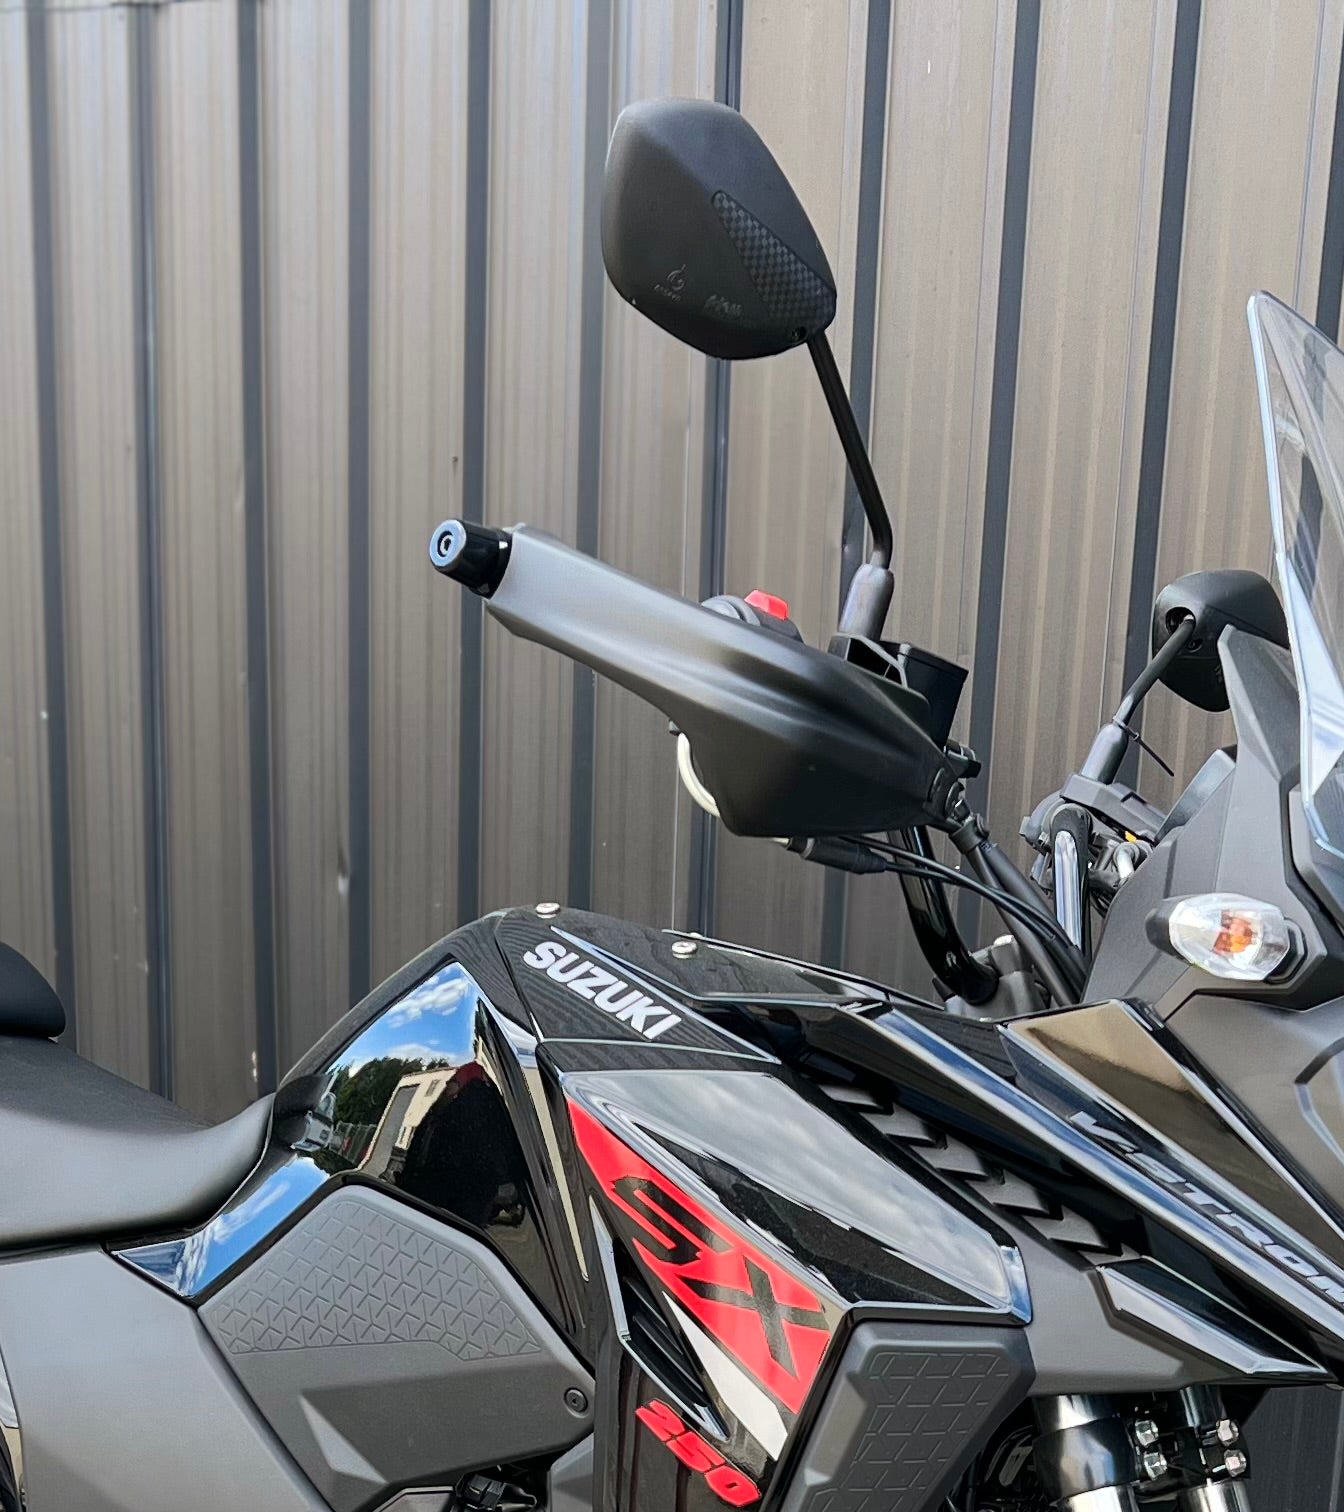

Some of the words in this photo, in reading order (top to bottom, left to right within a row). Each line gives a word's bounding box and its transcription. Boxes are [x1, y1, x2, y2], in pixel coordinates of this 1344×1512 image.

[523, 940, 682, 1041] SUZUKI
[610, 1175, 826, 1380] SX
[635, 1398, 763, 1508] 250
